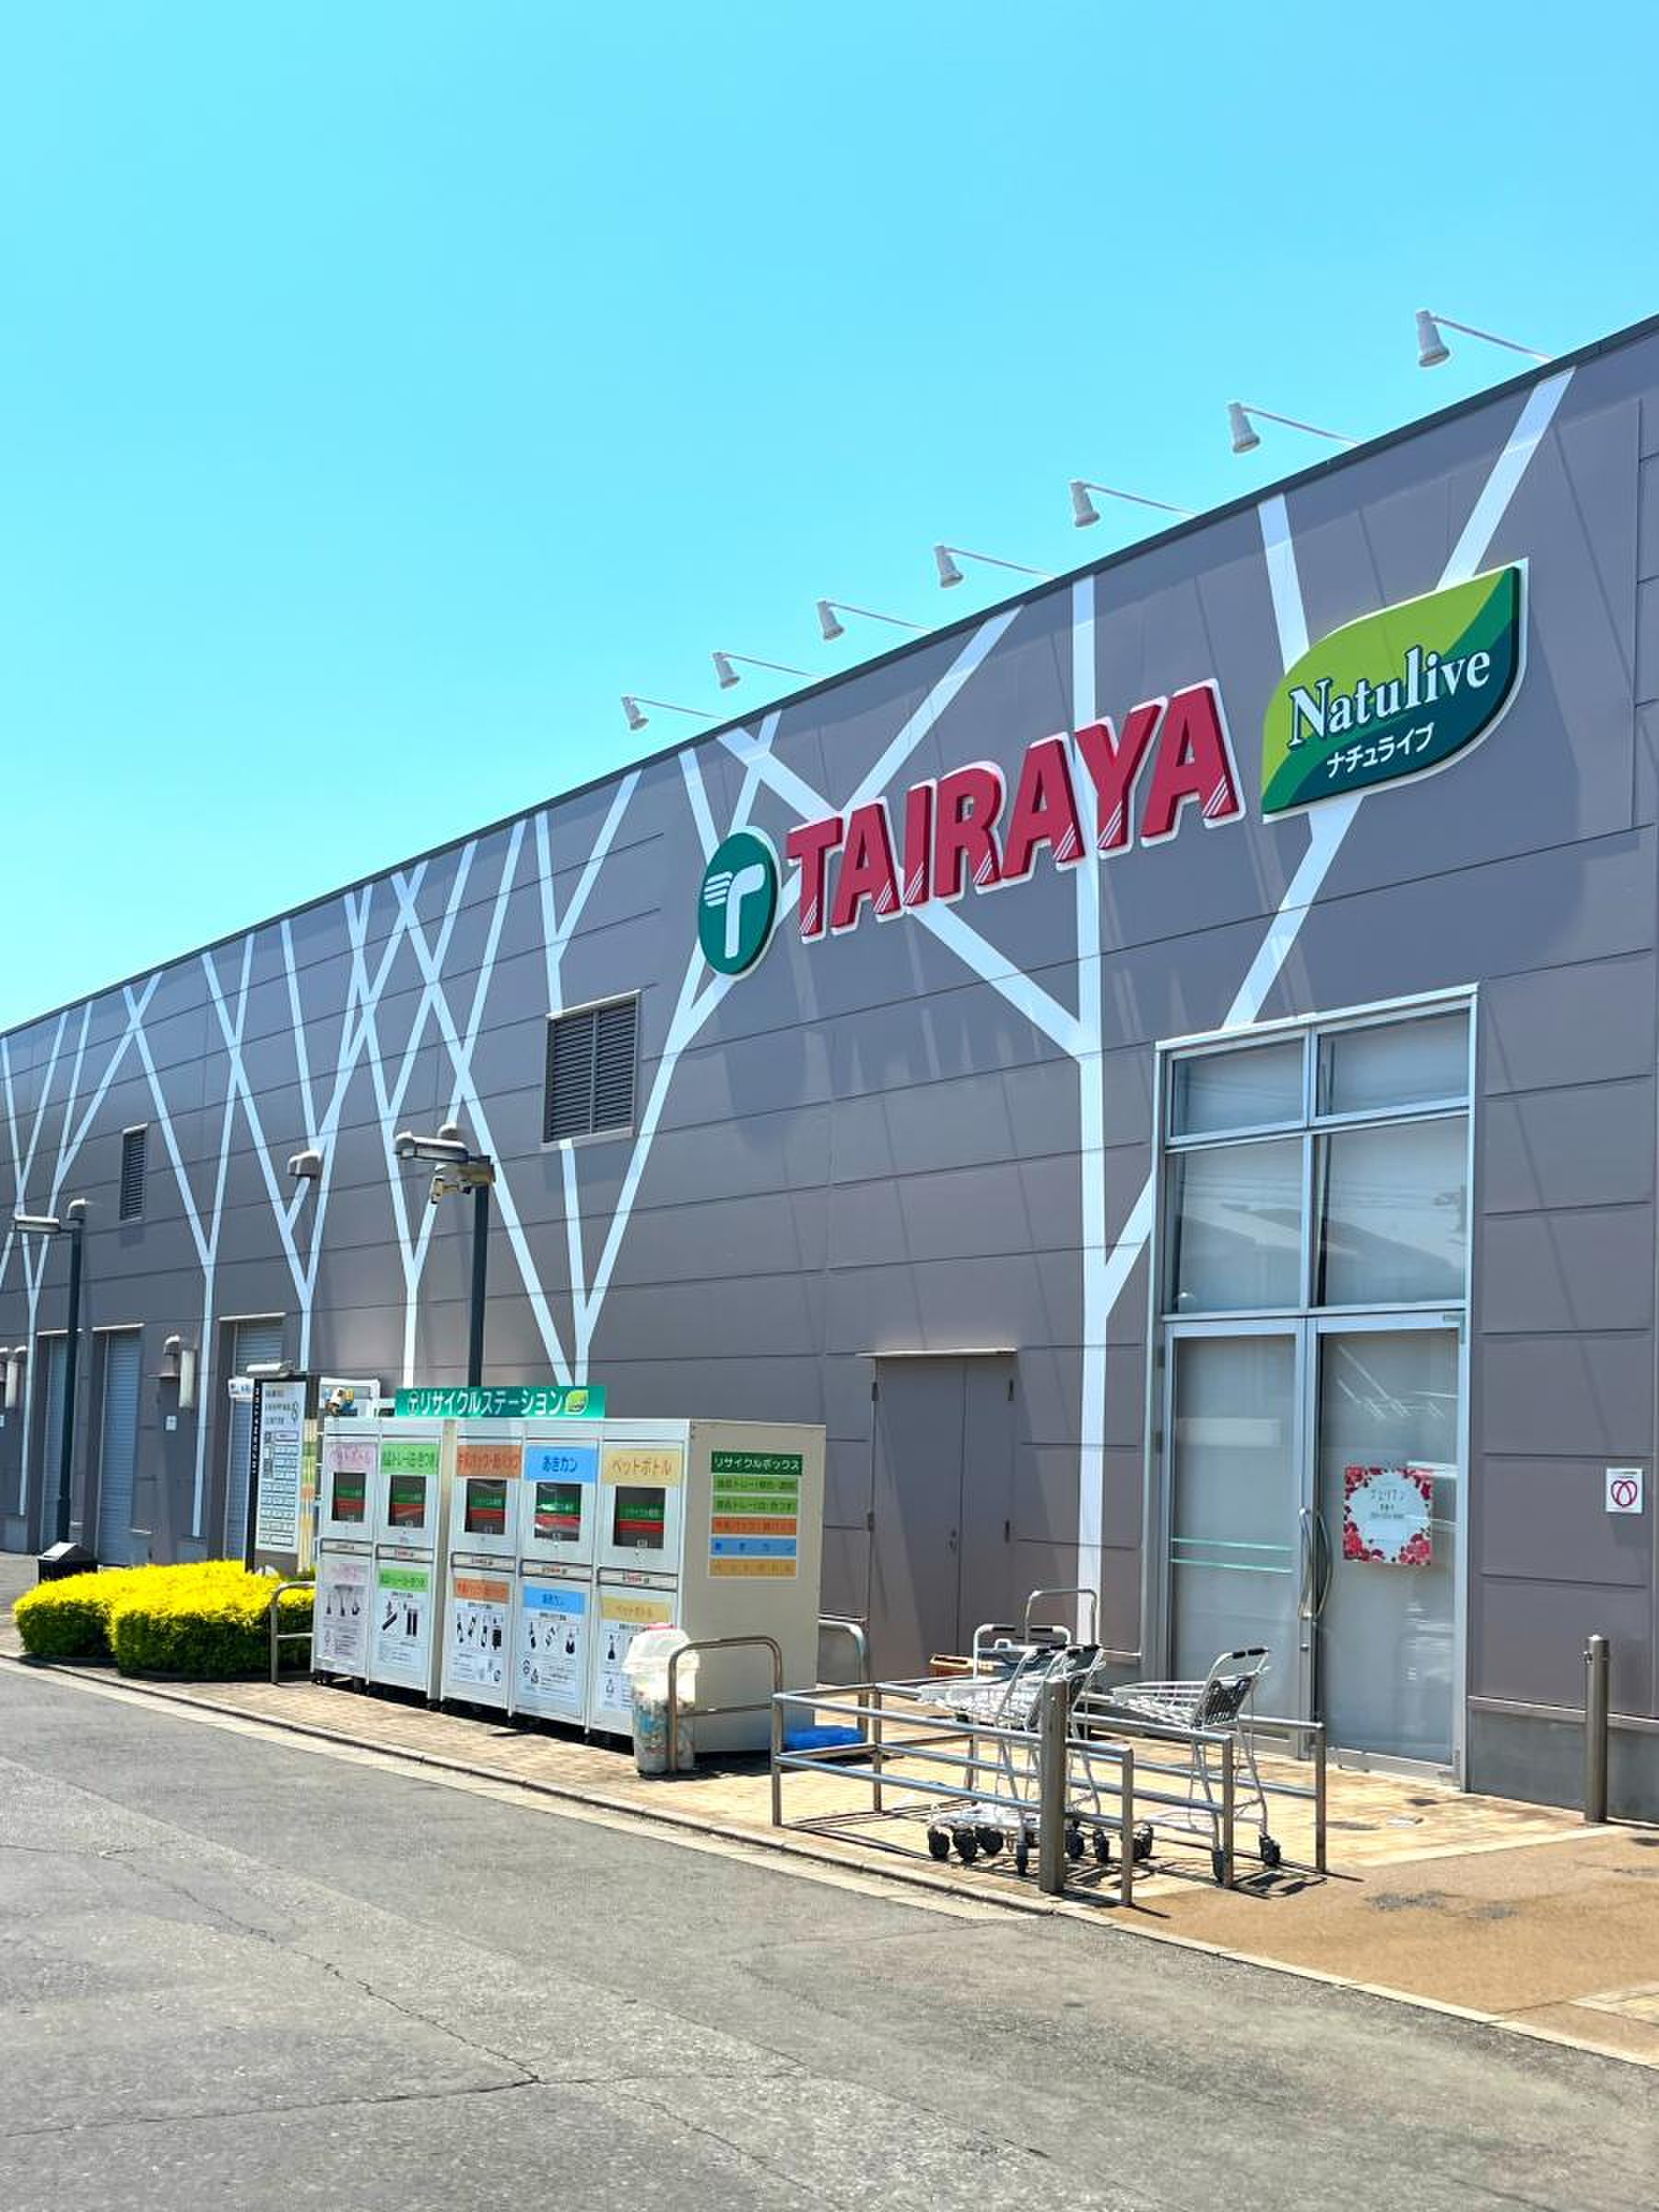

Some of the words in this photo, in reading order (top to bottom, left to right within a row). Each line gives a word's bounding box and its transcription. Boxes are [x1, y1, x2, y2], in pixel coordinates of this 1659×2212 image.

[1288, 645, 1491, 747] Natulive
[785, 679, 1244, 943] TAIRAYA
[419, 1388, 563, 1417] リサイクルステーション
[612, 1458, 673, 1477] ペットボトル
[714, 1456, 800, 1472] リサイクルボックス
